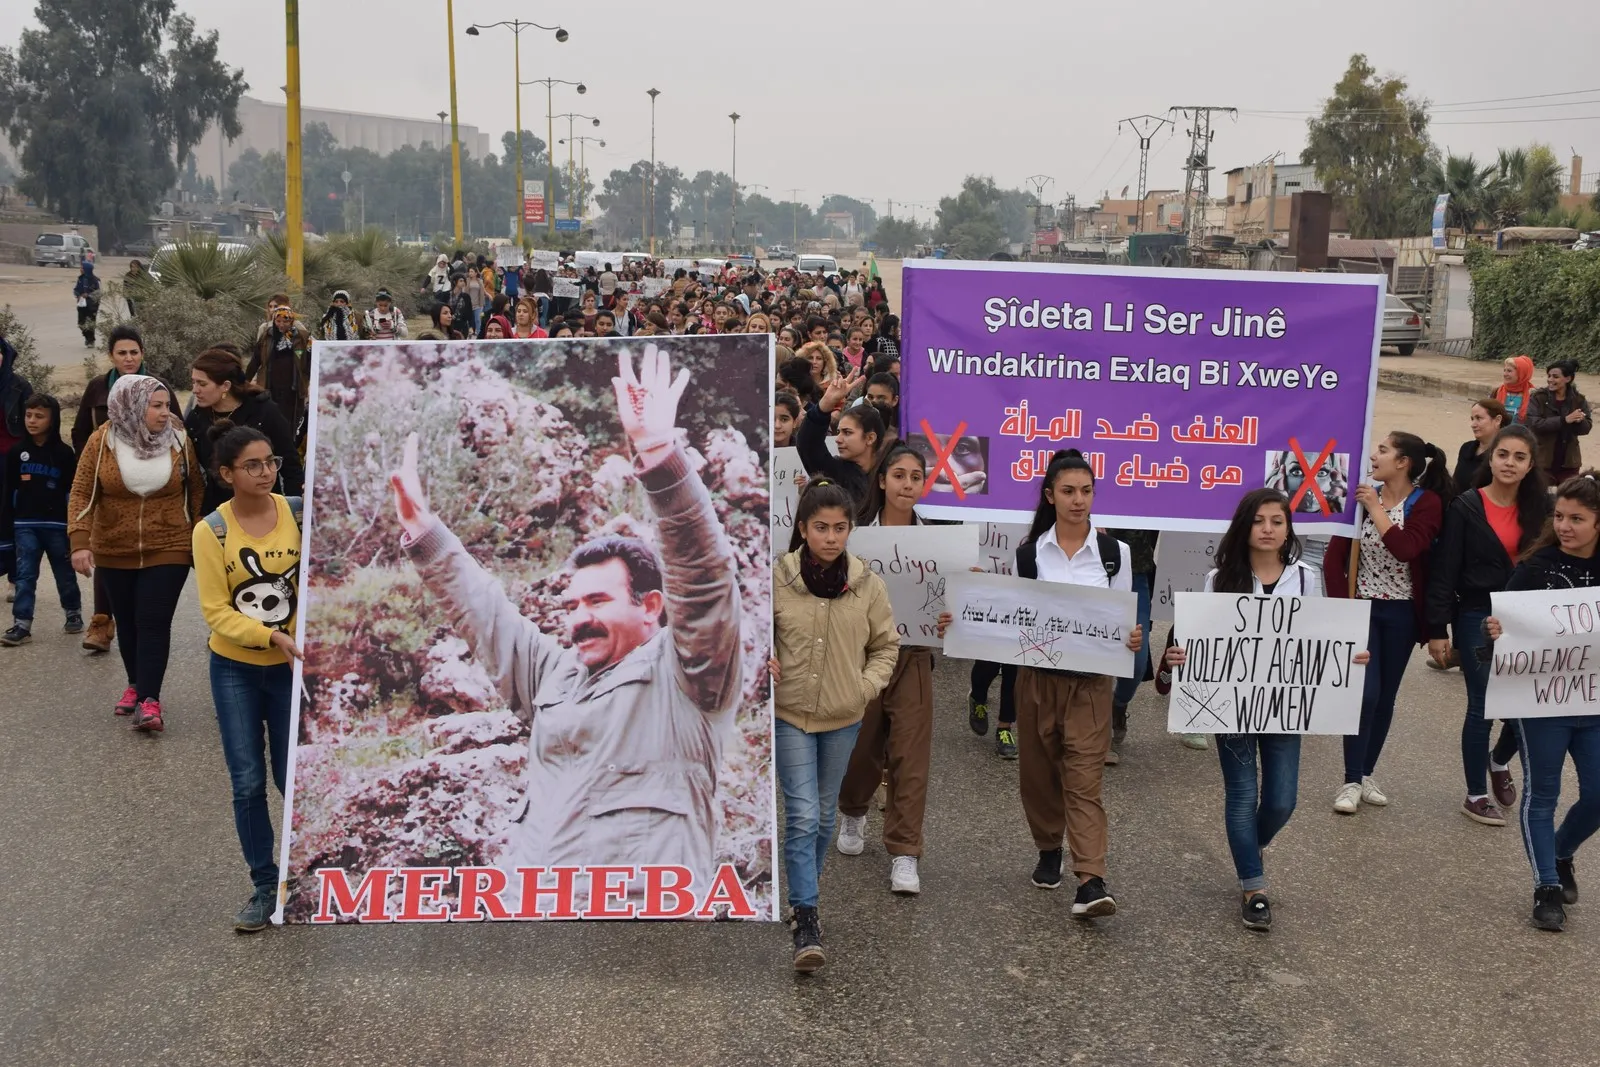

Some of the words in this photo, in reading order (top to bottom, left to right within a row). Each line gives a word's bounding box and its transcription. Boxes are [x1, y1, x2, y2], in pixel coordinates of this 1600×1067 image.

[438, 275, 445, 284] Z
[984, 295, 1093, 333] Şîdeta
[1103, 301, 1133, 332] Li
[1143, 303, 1203, 336] Ser
[1211, 307, 1287, 339] Jinê
[927, 347, 1101, 381] Windakirina
[1110, 356, 1190, 391] Exlaq
[1199, 360, 1229, 387] Bi
[1172, 415, 1258, 445] العنف
[1115, 454, 1189, 487] ضياع
[1200, 464, 1242, 490] هو
[264, 550, 283, 558] IT'S
[865, 543, 939, 584] adiya
[1234, 595, 1301, 635] STOP
[1267, 637, 1356, 688] AGAINST
[1494, 645, 1592, 676] VIOLENCE
[1534, 673, 1600, 704] WOME
[1234, 685, 1317, 733] WOMEN
[311, 863, 757, 924] MERHEBA
